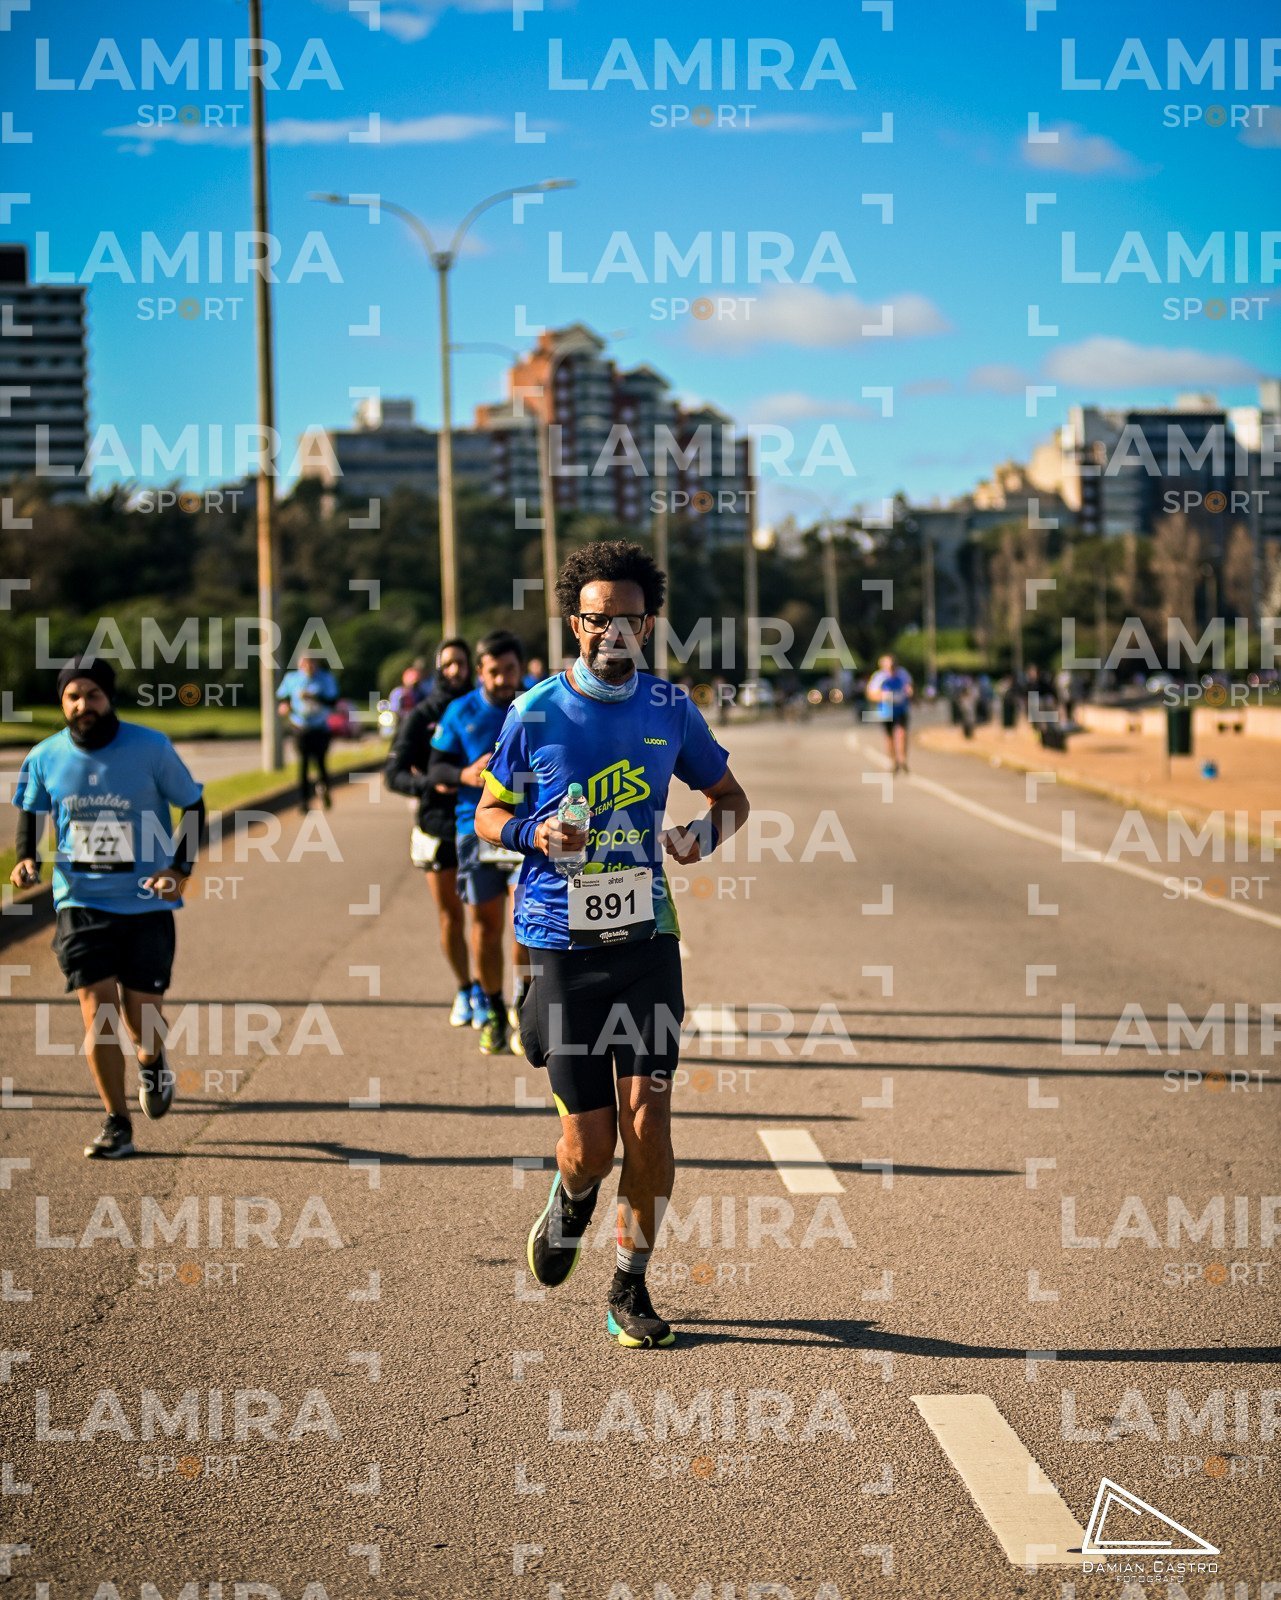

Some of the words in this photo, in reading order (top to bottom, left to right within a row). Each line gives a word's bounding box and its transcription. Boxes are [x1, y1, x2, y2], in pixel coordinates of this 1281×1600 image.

[643, 737, 668, 746] woom
[594, 800, 613, 816] TEAM
[82, 836, 120, 856] 127
[585, 889, 635, 921] 891
